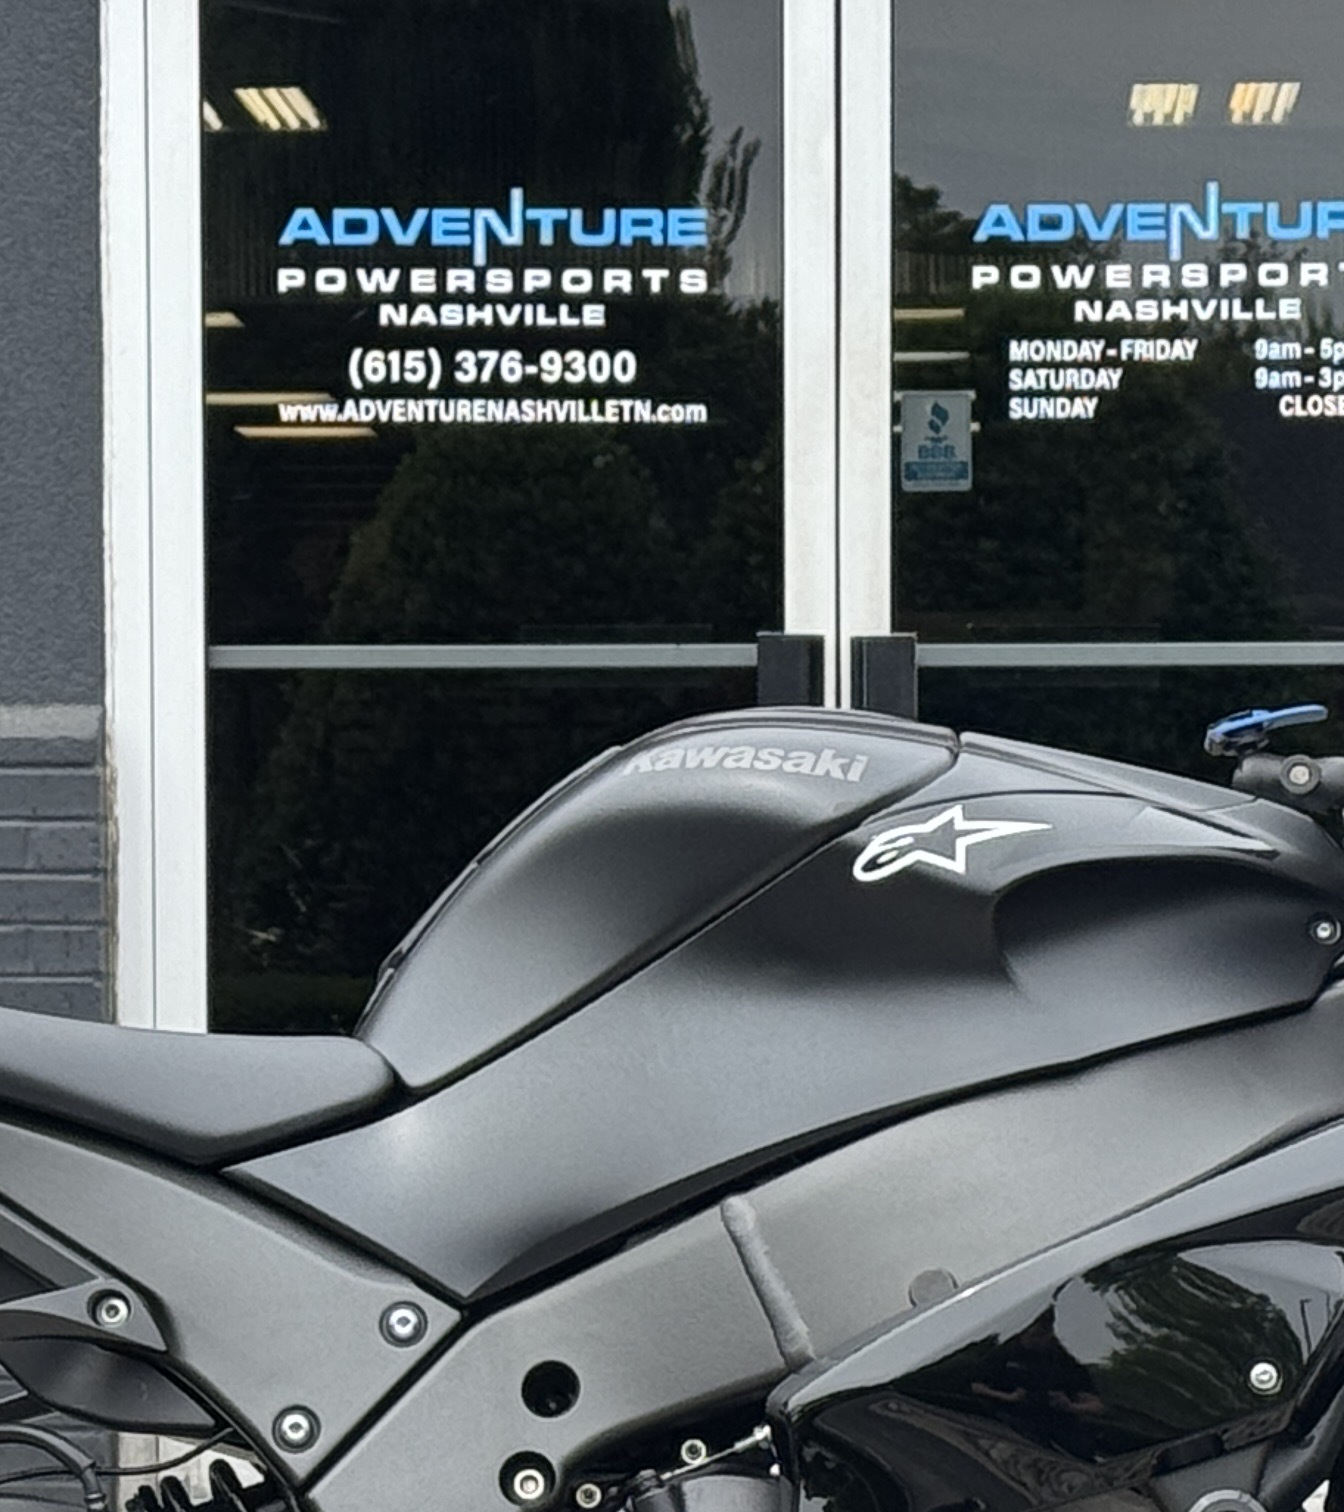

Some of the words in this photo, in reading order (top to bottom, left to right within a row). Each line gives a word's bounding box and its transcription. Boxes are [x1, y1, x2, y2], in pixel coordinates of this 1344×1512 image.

[278, 187, 709, 267] ADVENTURE
[276, 267, 709, 294] POWERSPORTS
[378, 303, 606, 327] NASHVILLE
[1074, 297, 1302, 321] NASHVILLE
[348, 348, 442, 389] (615)
[454, 349, 638, 384] 376-9300
[1008, 367, 1124, 391] SATURDAY
[277, 399, 708, 424] www.ADVENTURENASHVILLETN.com
[1008, 396, 1099, 420] SUNDAY
[623, 744, 868, 783] Kawasaki
